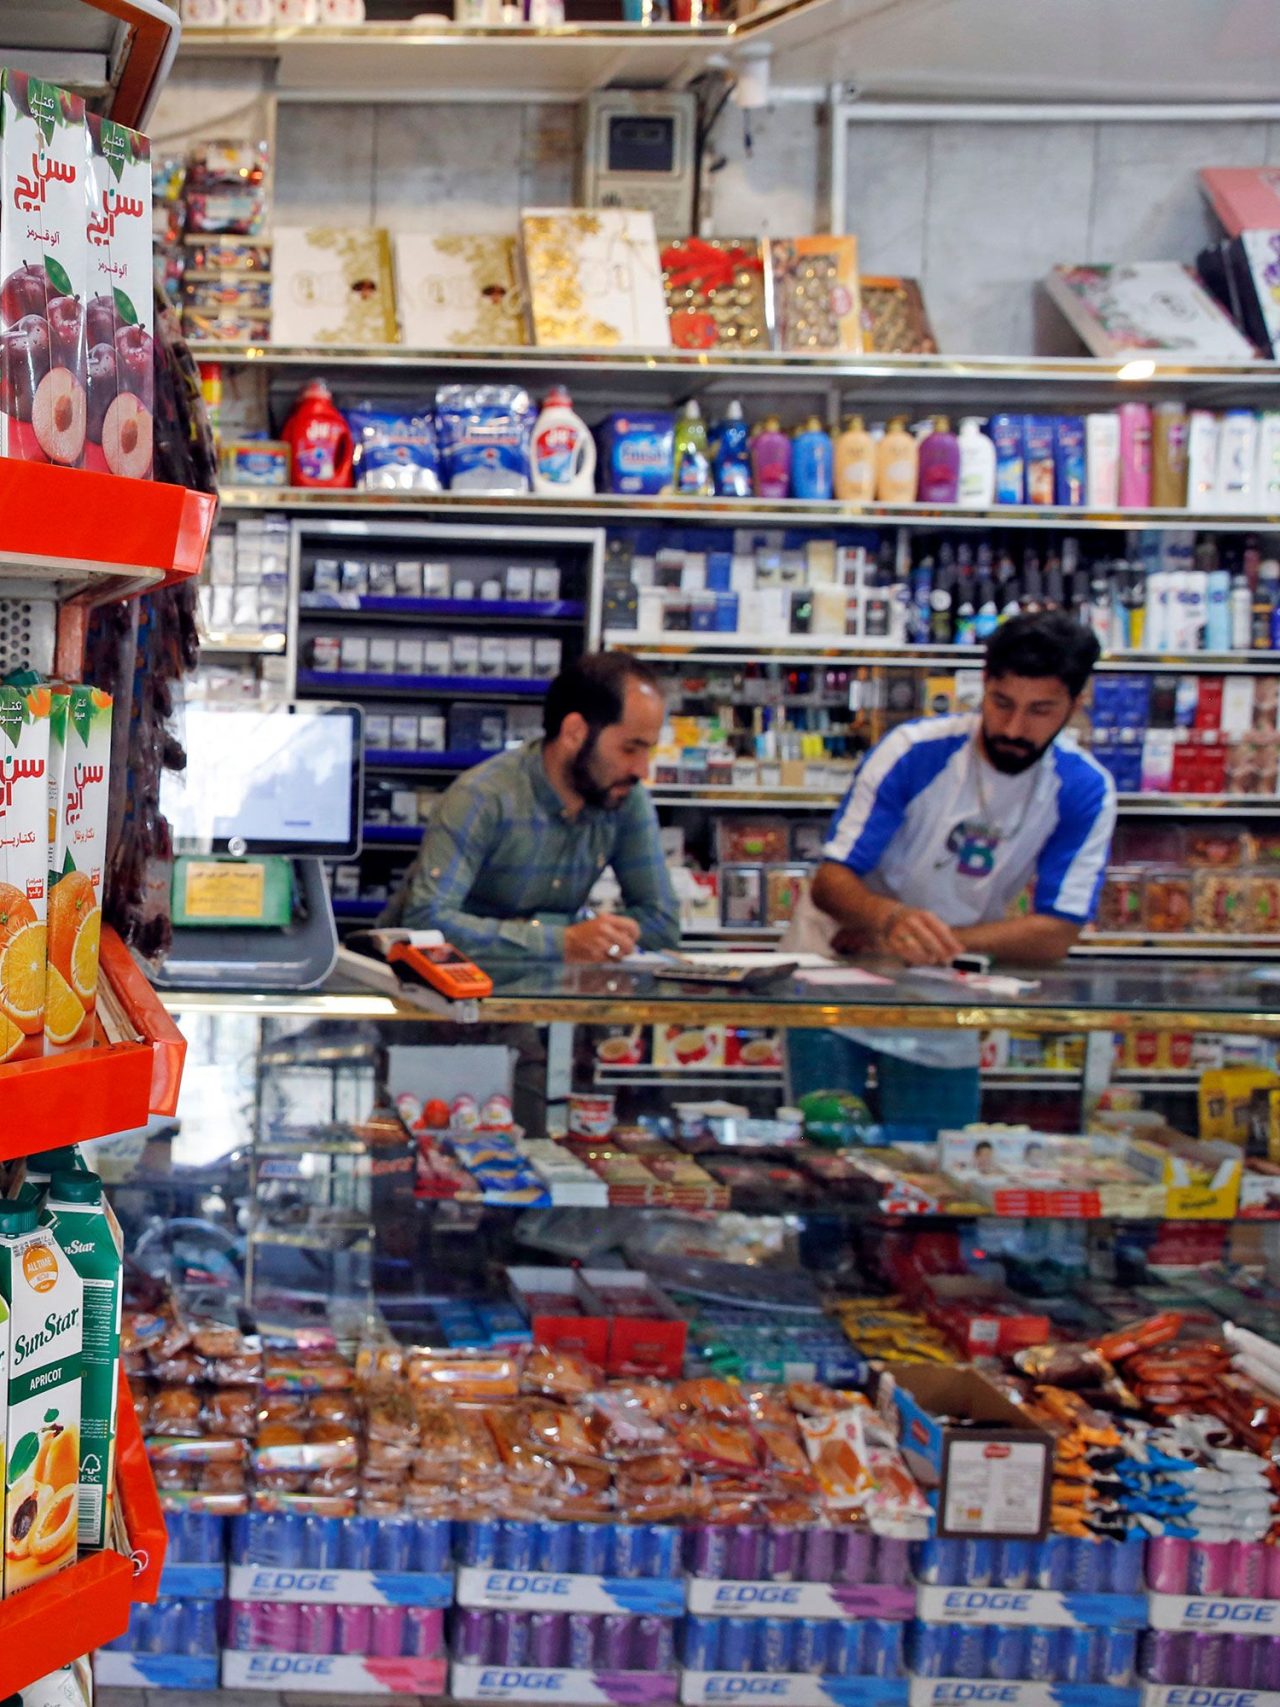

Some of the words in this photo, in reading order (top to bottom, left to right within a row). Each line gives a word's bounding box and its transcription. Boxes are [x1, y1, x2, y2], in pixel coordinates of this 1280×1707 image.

[30, 92, 55, 109] نکتار
[30, 106, 55, 122] میوه
[102, 147, 125, 161] میوه
[32, 151, 76, 184] سن
[13, 174, 46, 212] ایچ
[102, 188, 144, 218] سن
[26, 224, 50, 241] قرمز
[49, 230, 60, 247] آلو
[74, 762, 103, 789] سن
[66, 787, 83, 827] ایچ
[13, 831, 36, 847] نکتار
[14, 1307, 79, 1366] SunStar
[29, 1368, 62, 1391] APRICOT
[253, 1573, 339, 1592] EDGE
[485, 1575, 571, 1595] EDGE
[713, 1584, 802, 1604] EDGE
[943, 1590, 1031, 1611] EDGE
[1184, 1602, 1277, 1622] EDGE
[248, 1657, 334, 1675] EDGE
[479, 1671, 564, 1690] EDGE
[703, 1676, 791, 1696] EDGE
[933, 1682, 1020, 1702] EDGE
